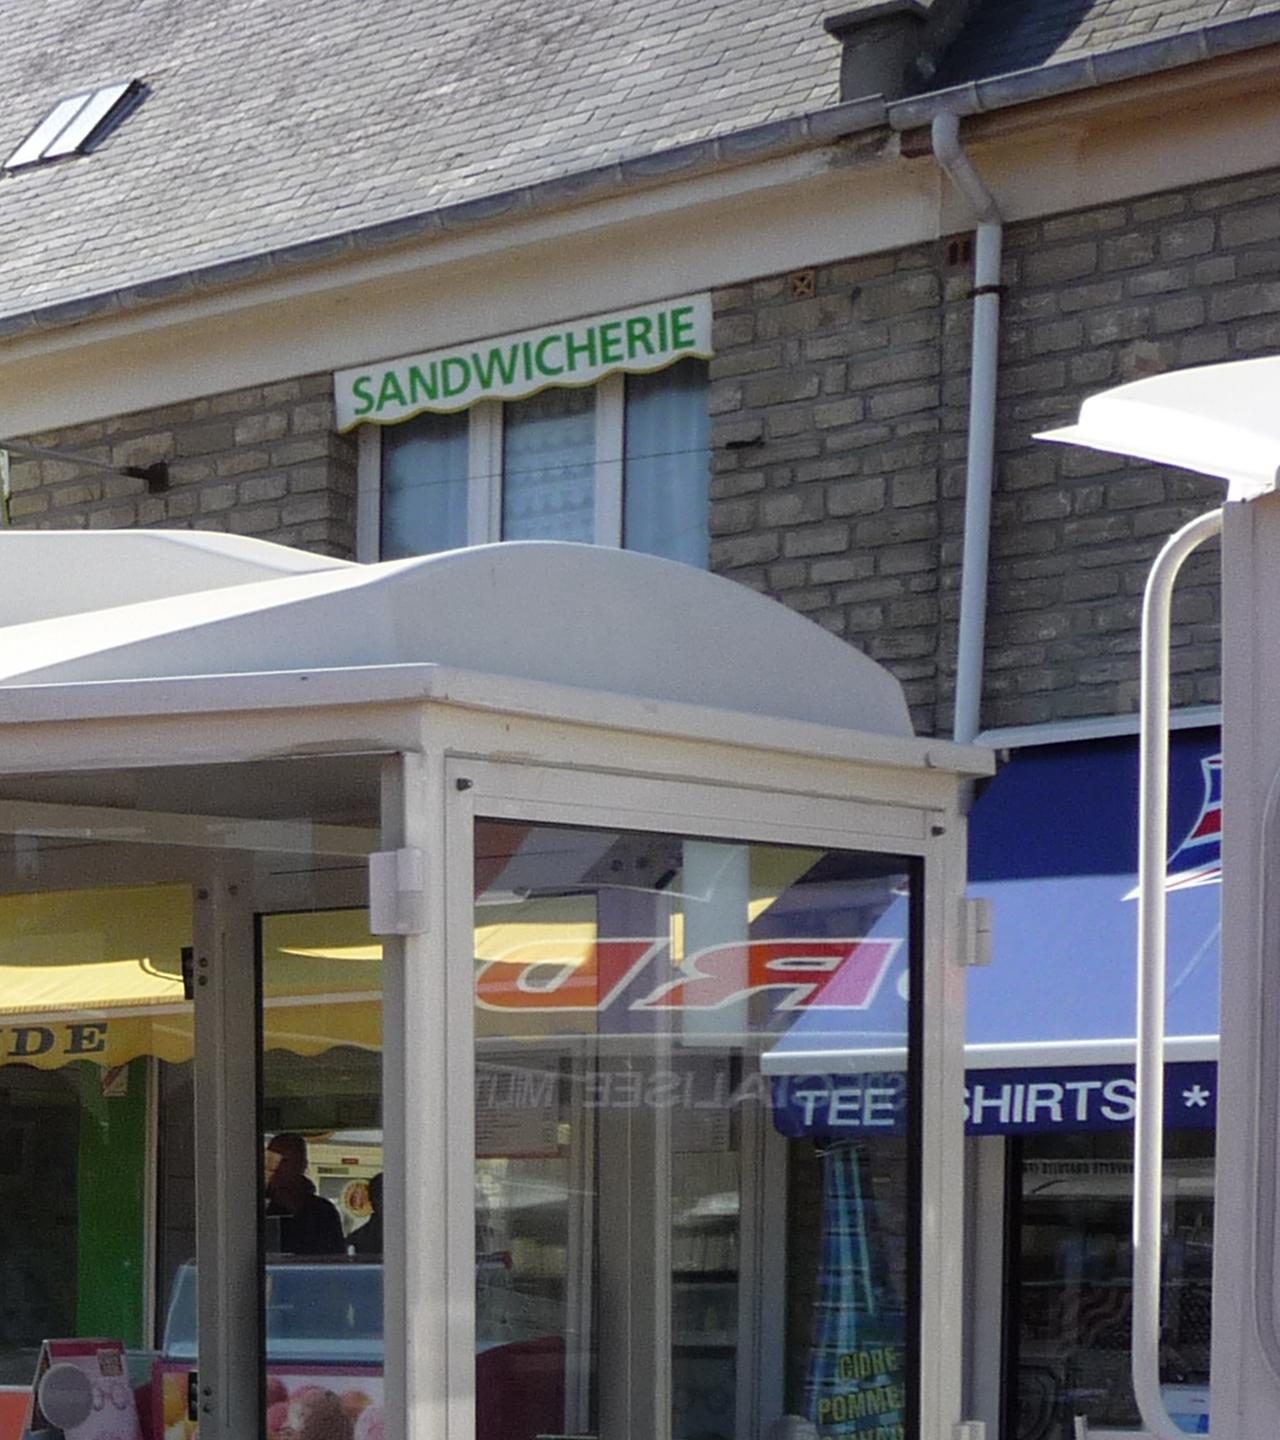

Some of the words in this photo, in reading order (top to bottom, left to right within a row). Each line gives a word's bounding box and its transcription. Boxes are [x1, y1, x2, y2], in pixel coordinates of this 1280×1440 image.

[352, 305, 696, 416] SANDWICHERIE
[796, 1088, 896, 1127] TEE
[963, 1079, 1138, 1125] HIRTS
